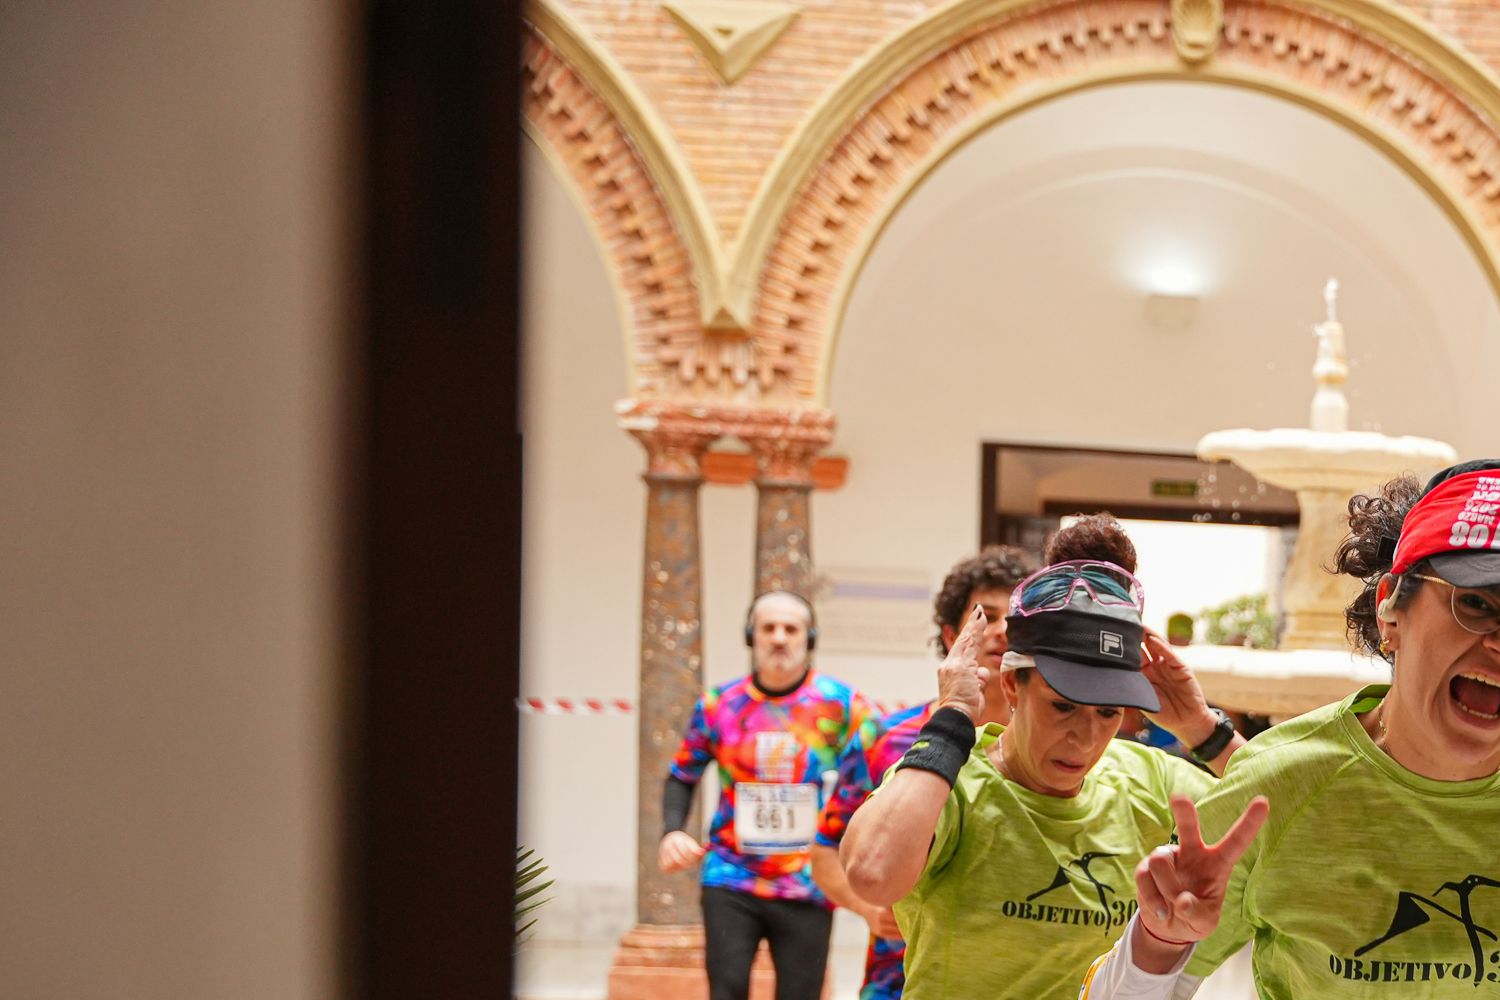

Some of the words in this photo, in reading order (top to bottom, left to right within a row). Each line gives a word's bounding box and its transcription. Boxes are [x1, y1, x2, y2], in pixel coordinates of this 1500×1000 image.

[1458, 512, 1495, 525] MARZO
[1449, 521, 1490, 548] 08
[1002, 900, 1106, 927] OBJETIVO
[1112, 899, 1137, 927] 30
[1329, 953, 1473, 983] OBJETIVO
